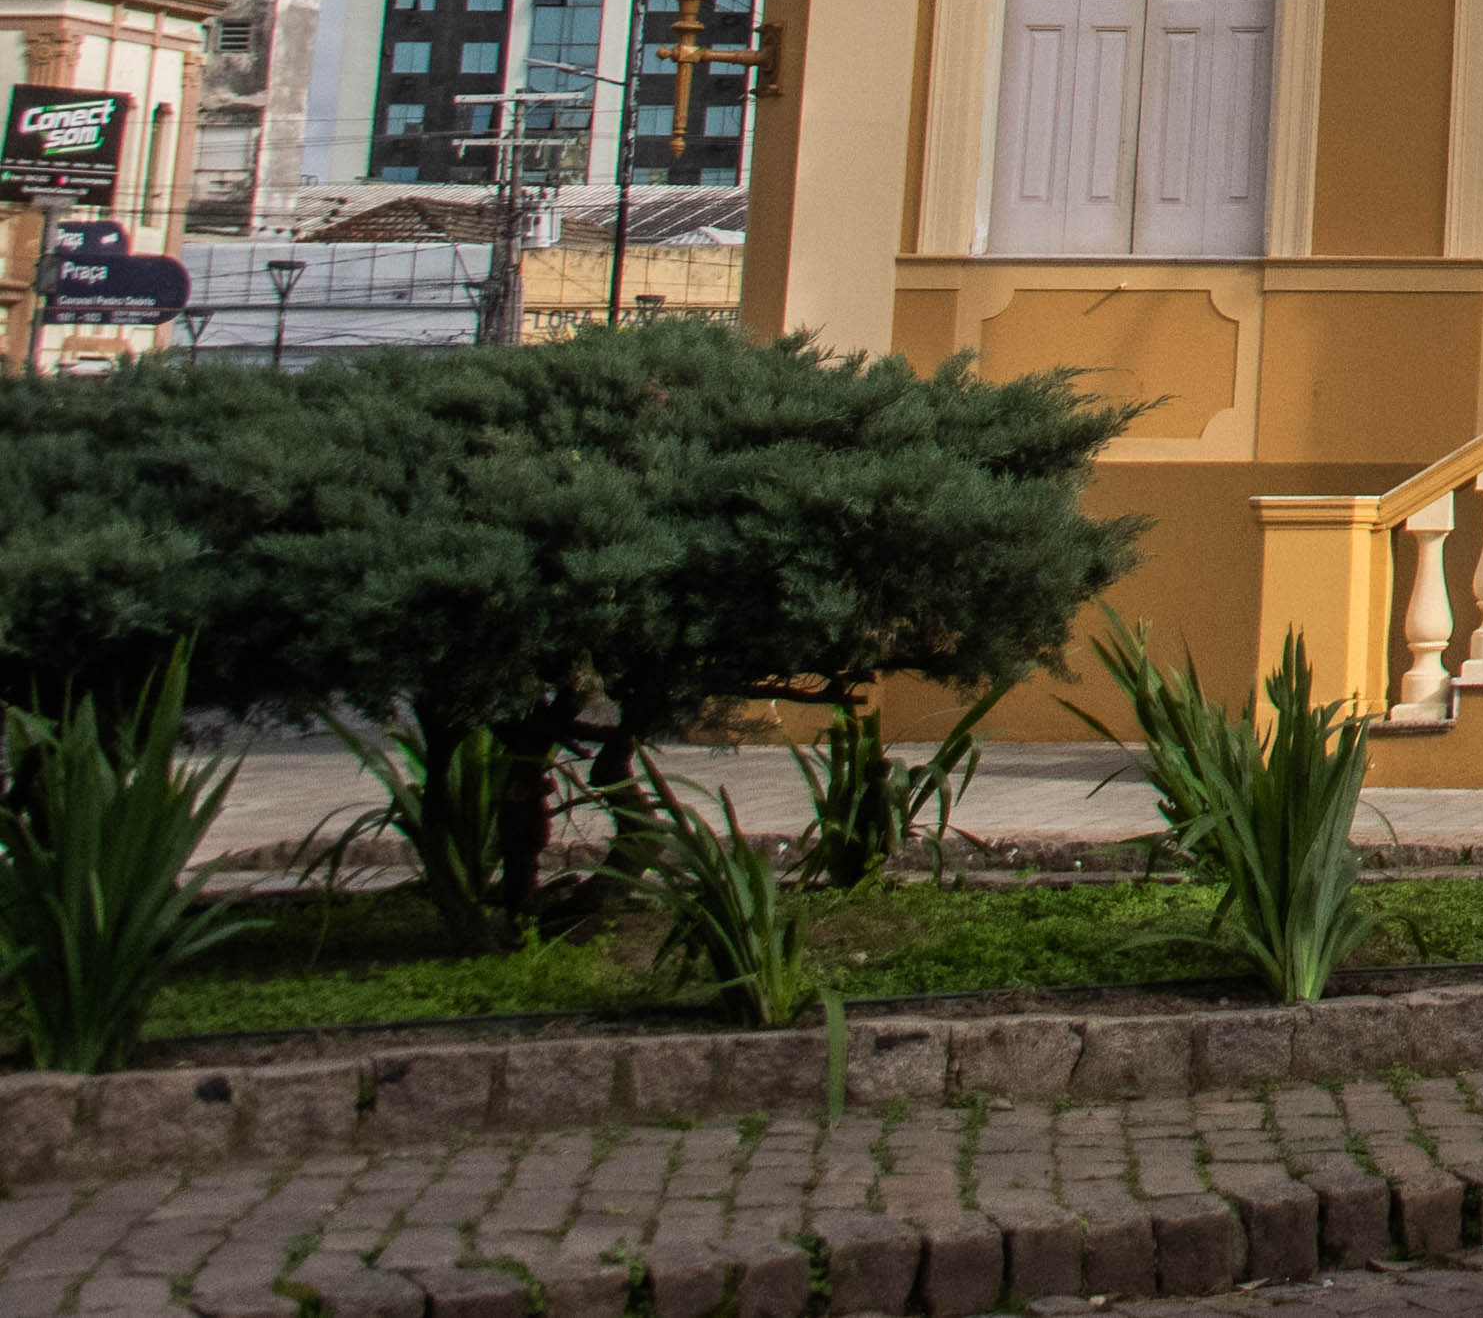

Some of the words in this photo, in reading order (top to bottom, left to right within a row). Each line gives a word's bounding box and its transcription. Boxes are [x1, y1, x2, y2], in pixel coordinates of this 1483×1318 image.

[18, 98, 116, 134] Conect
[42, 125, 101, 149] som
[61, 261, 108, 285] Praça
